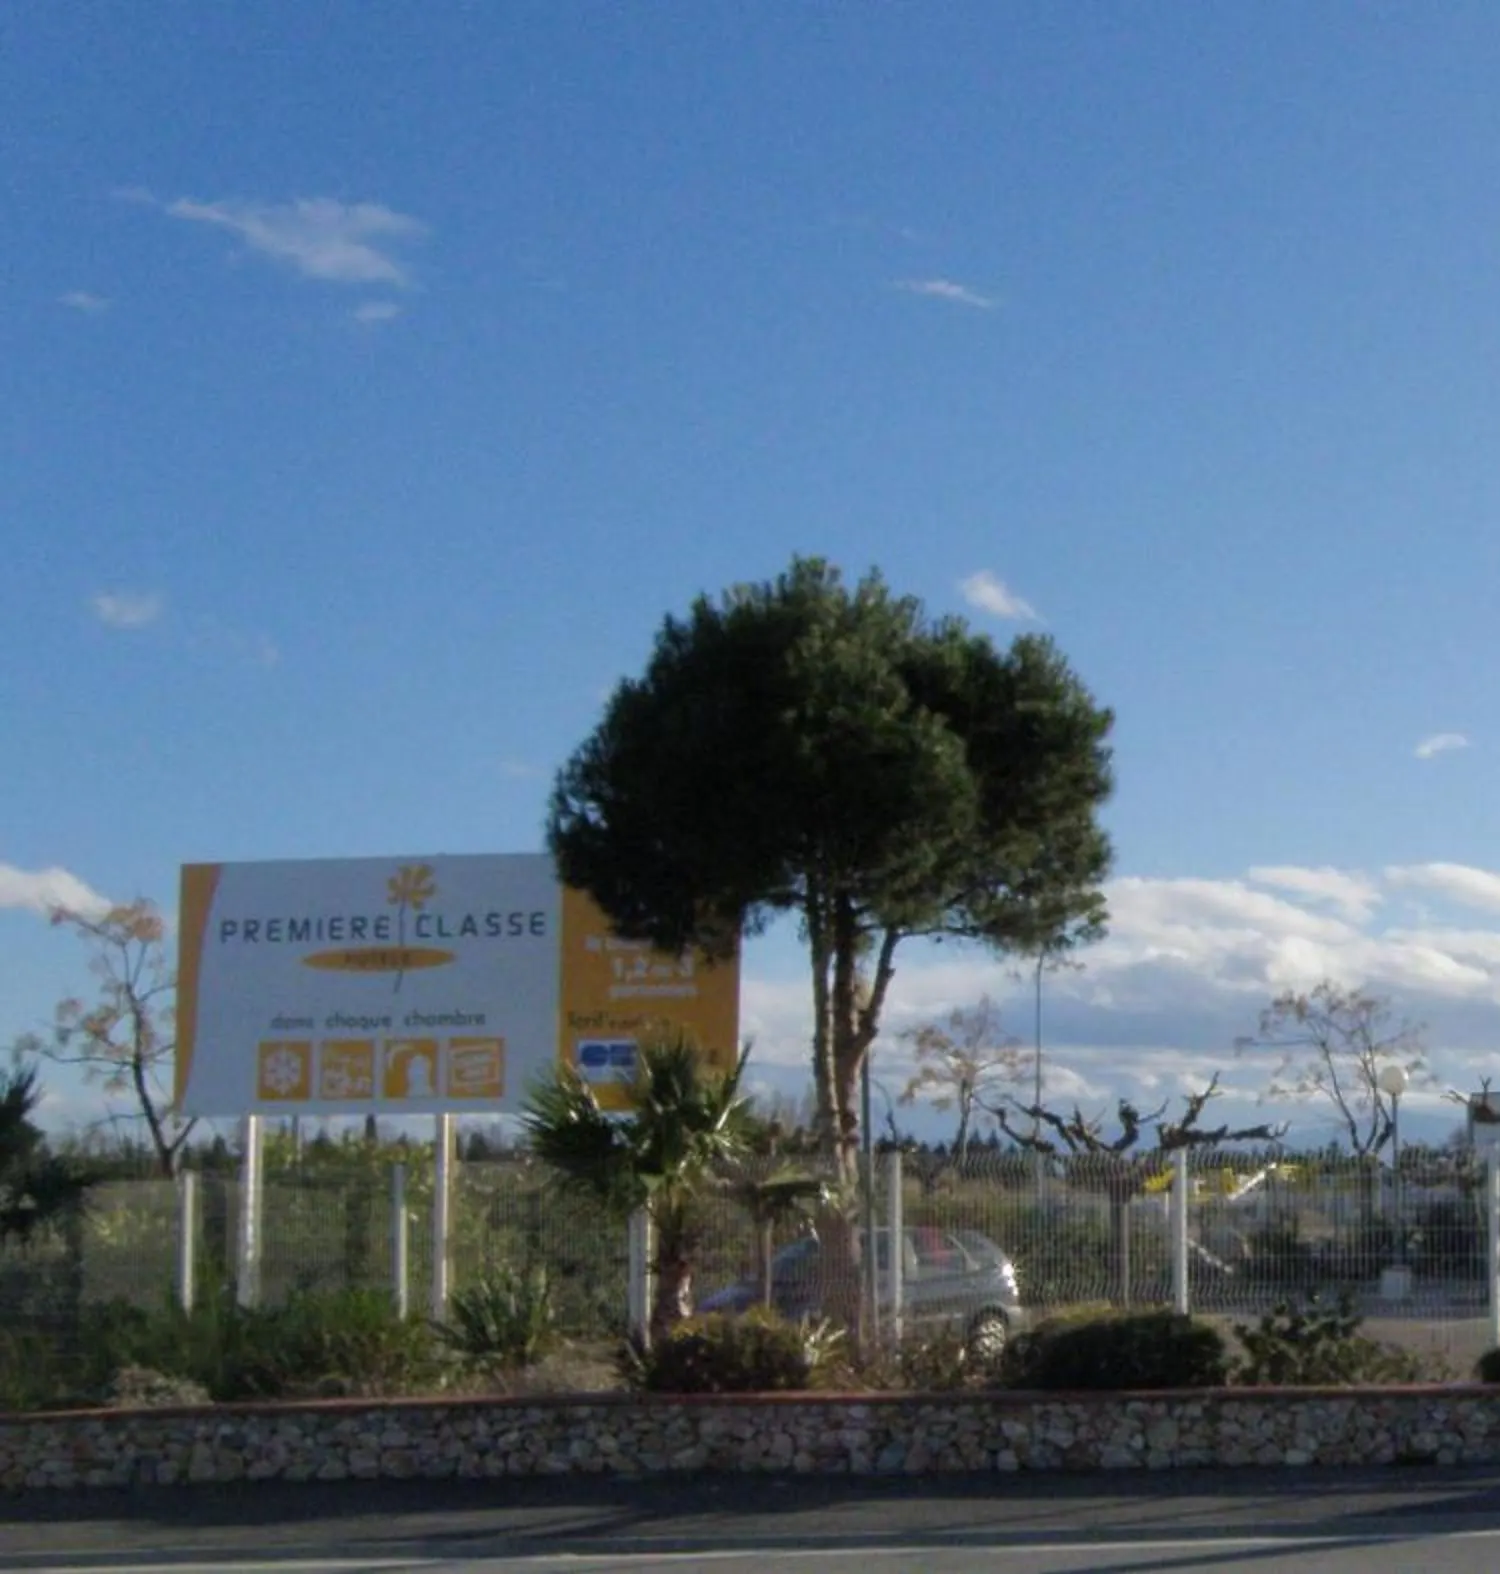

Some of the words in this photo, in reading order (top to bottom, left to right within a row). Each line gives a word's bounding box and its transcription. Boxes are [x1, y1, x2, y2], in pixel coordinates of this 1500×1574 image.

[219, 915, 390, 943] PREMIERE
[415, 911, 546, 938] CLASSE
[325, 1012, 392, 1030] chaque
[404, 1008, 485, 1026] chambre
